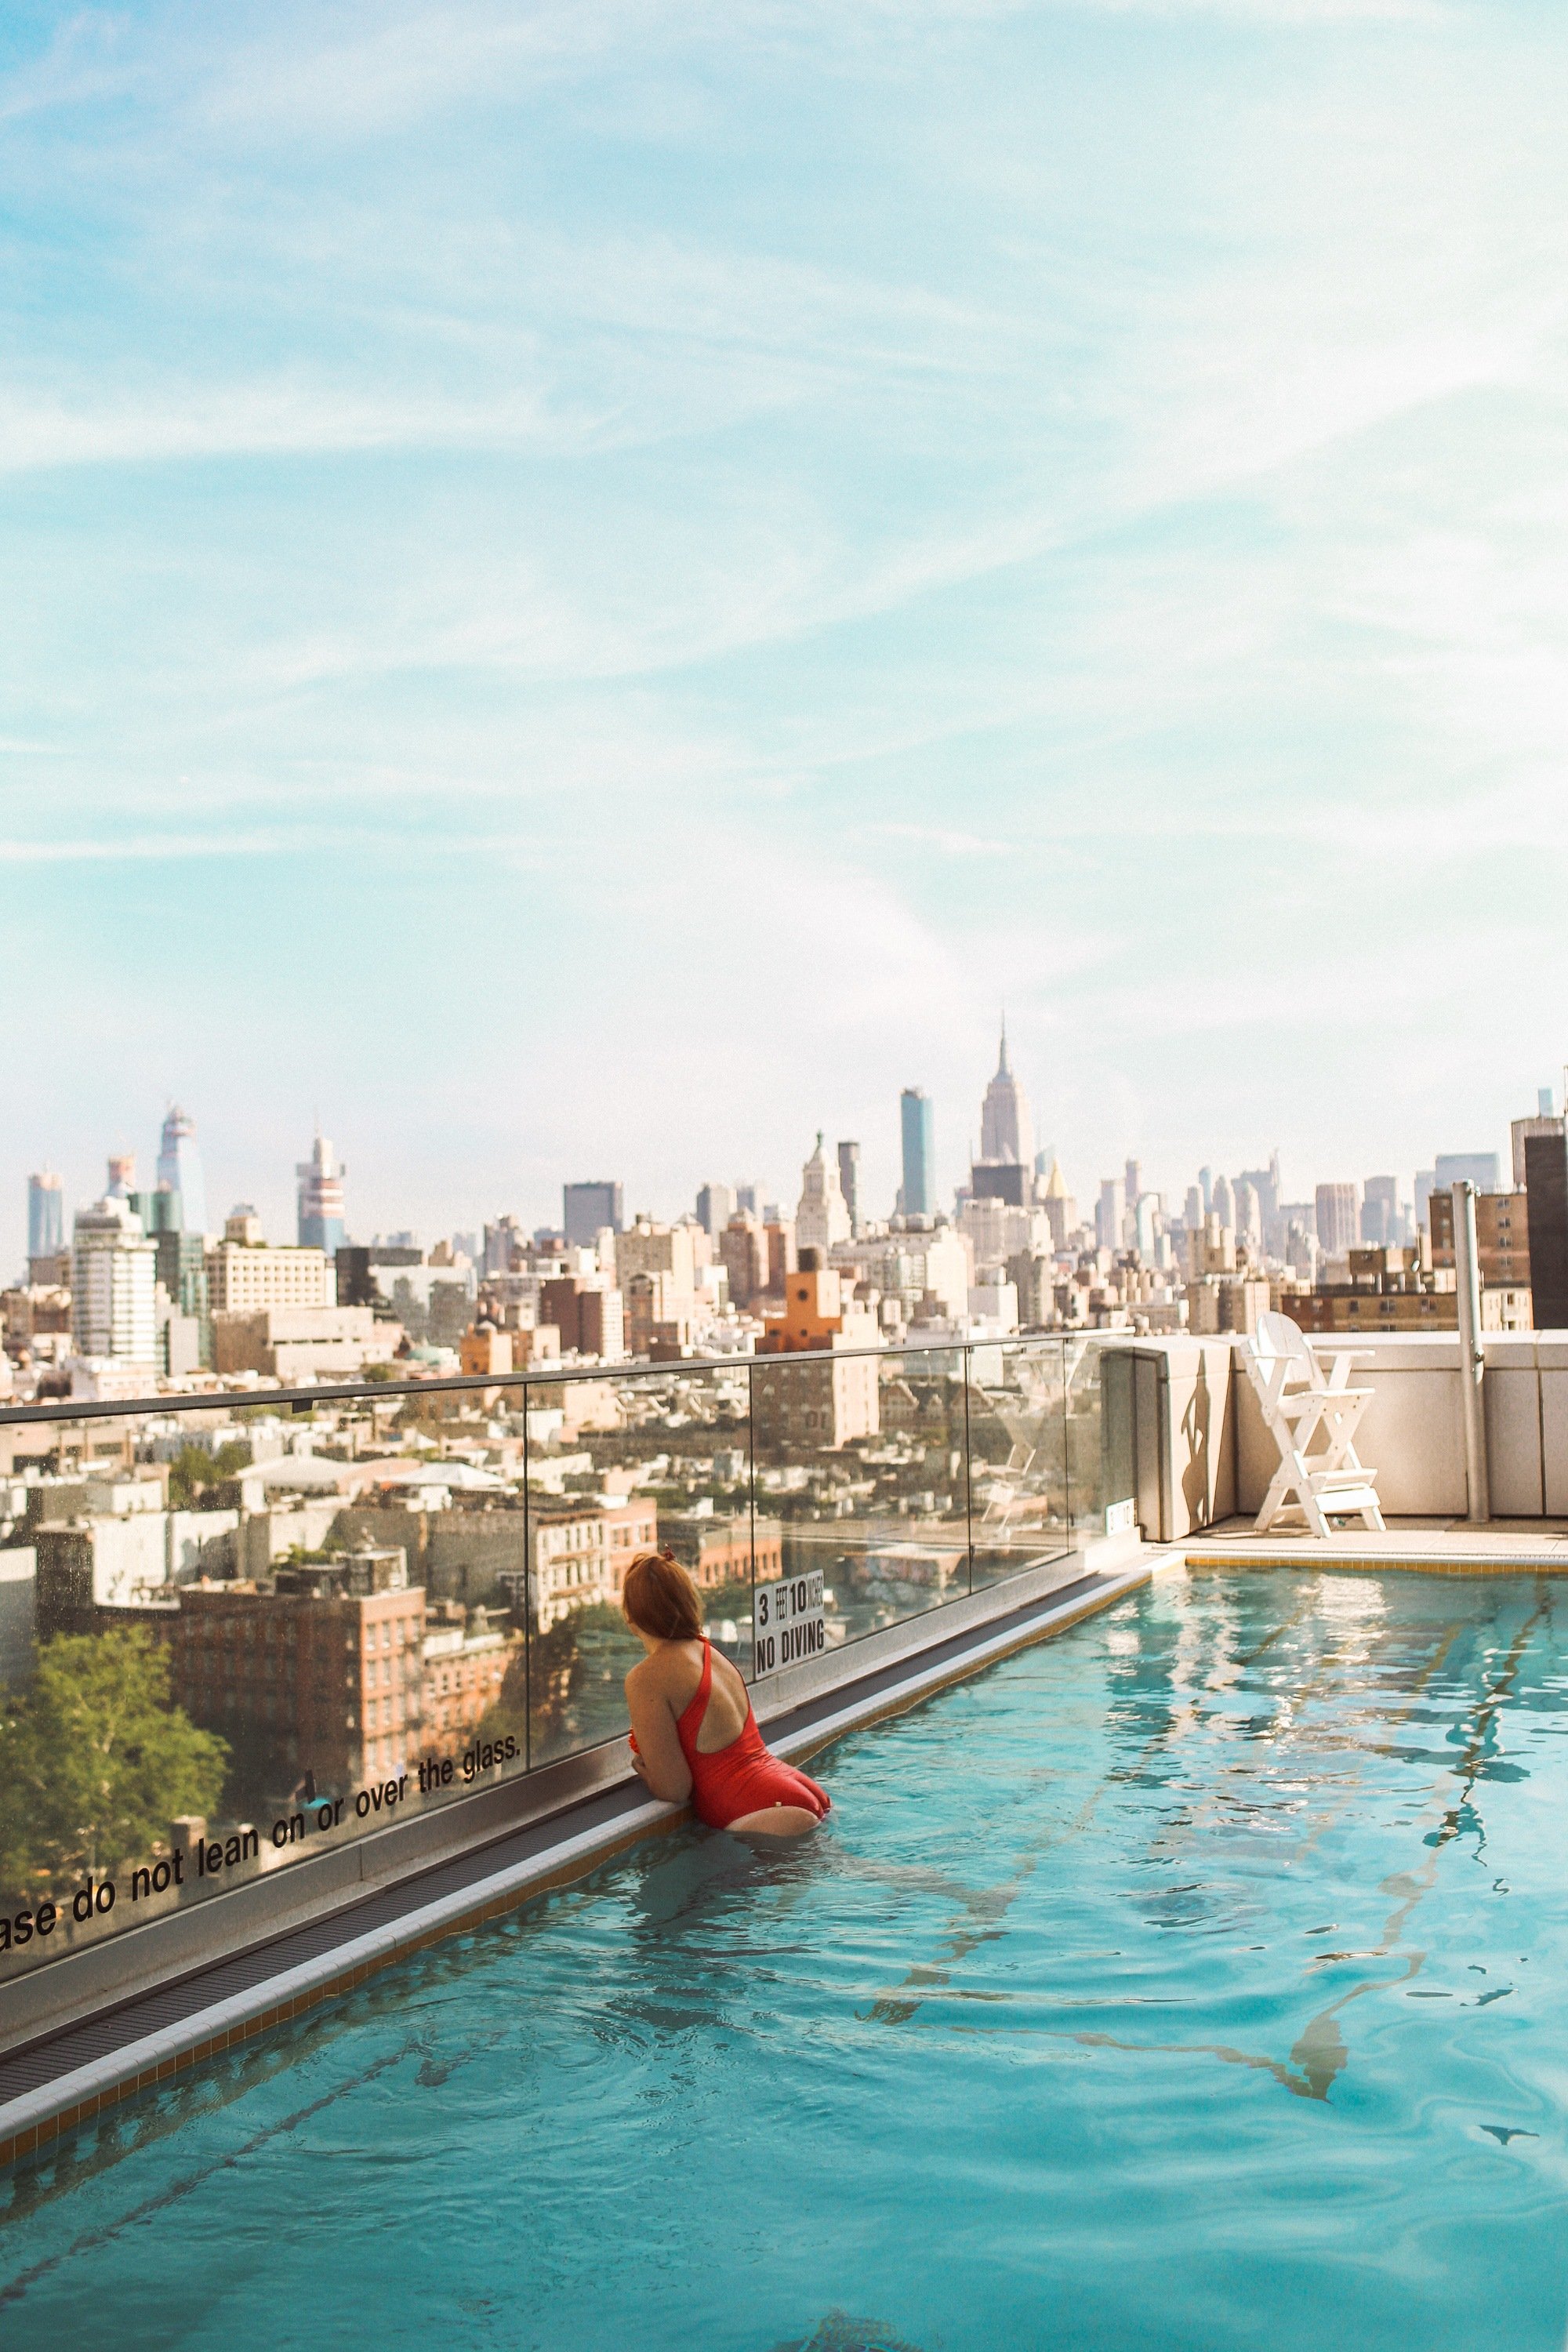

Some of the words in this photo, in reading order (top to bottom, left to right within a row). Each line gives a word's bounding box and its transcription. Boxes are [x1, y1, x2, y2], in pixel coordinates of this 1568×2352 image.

[759, 1593, 769, 1626] 3
[776, 1585, 788, 1621] FEET
[790, 1580, 807, 1616] 10
[757, 1635, 775, 1674] NO
[782, 1618, 824, 1664] DIVING
[73, 1875, 116, 1922] do
[132, 1848, 184, 1902] not
[198, 1828, 260, 1877] lean
[272, 1813, 305, 1849] on
[318, 1797, 344, 1831] or
[356, 1773, 408, 1818] over
[418, 1757, 454, 1794] the
[463, 1735, 521, 1784] glass.
